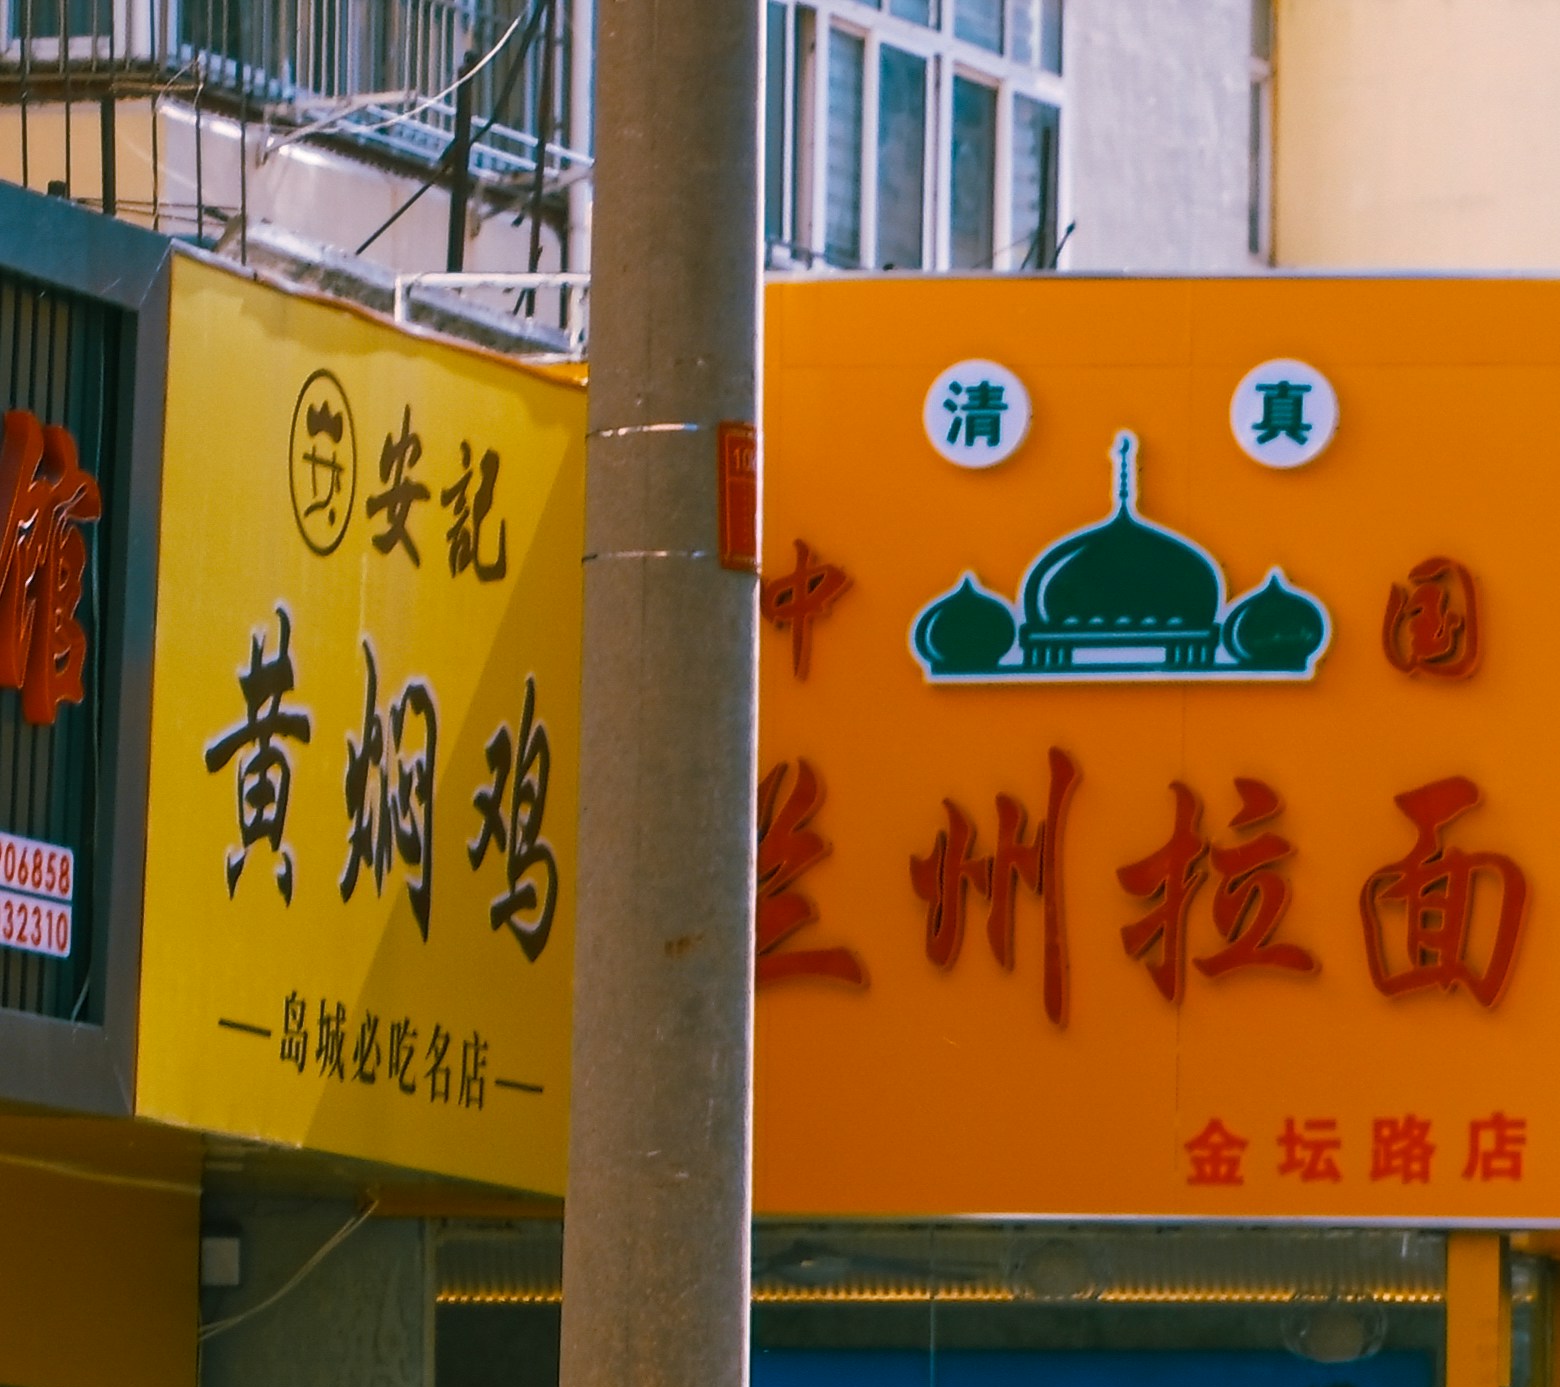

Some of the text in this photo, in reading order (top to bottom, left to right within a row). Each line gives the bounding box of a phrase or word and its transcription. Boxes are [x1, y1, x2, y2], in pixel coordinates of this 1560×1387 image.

[942, 380, 1314, 448] 清 真
[1383, 557, 1483, 683] 国
[204, 603, 560, 964] 黄焖鸡
[0, 840, 71, 896] 06858
[755, 747, 1529, 1030] 兰州拉面
[1183, 1113, 1528, 1186] 金坛路店
